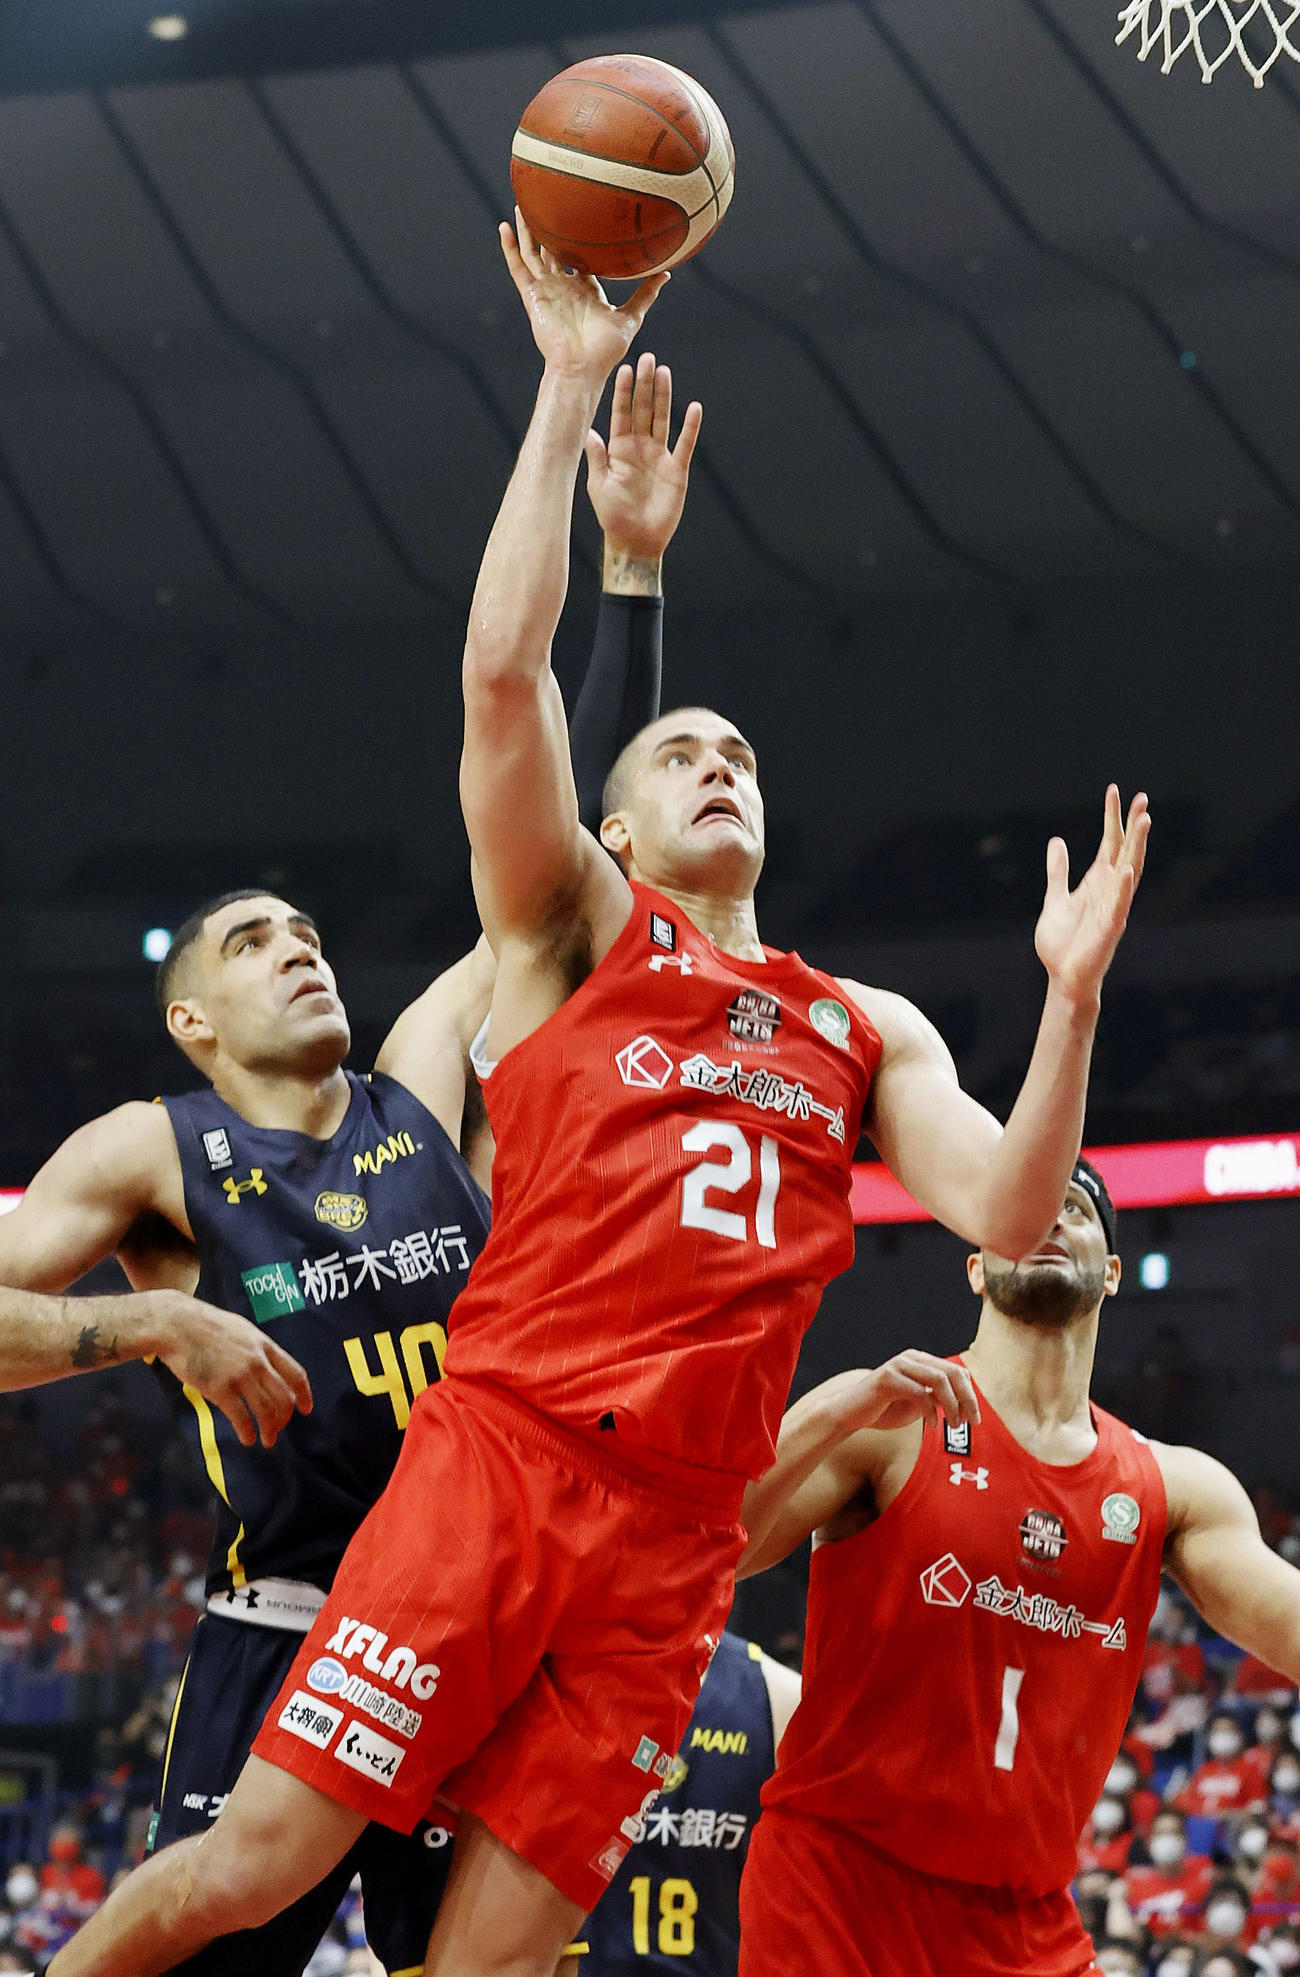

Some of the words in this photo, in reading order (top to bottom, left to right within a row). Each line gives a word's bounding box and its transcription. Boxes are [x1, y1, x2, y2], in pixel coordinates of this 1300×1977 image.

[679, 1053, 847, 1144] 金太郎ホーム
[680, 1119, 781, 1250] 21
[299, 1225, 471, 1306] 栃木銀行
[343, 1321, 450, 1431] 40
[973, 1575, 1127, 1652] 金太郎ホーム
[324, 1616, 441, 1700] XFLAG
[994, 1666, 1026, 1772] 1
[628, 1875, 699, 1956] 18
